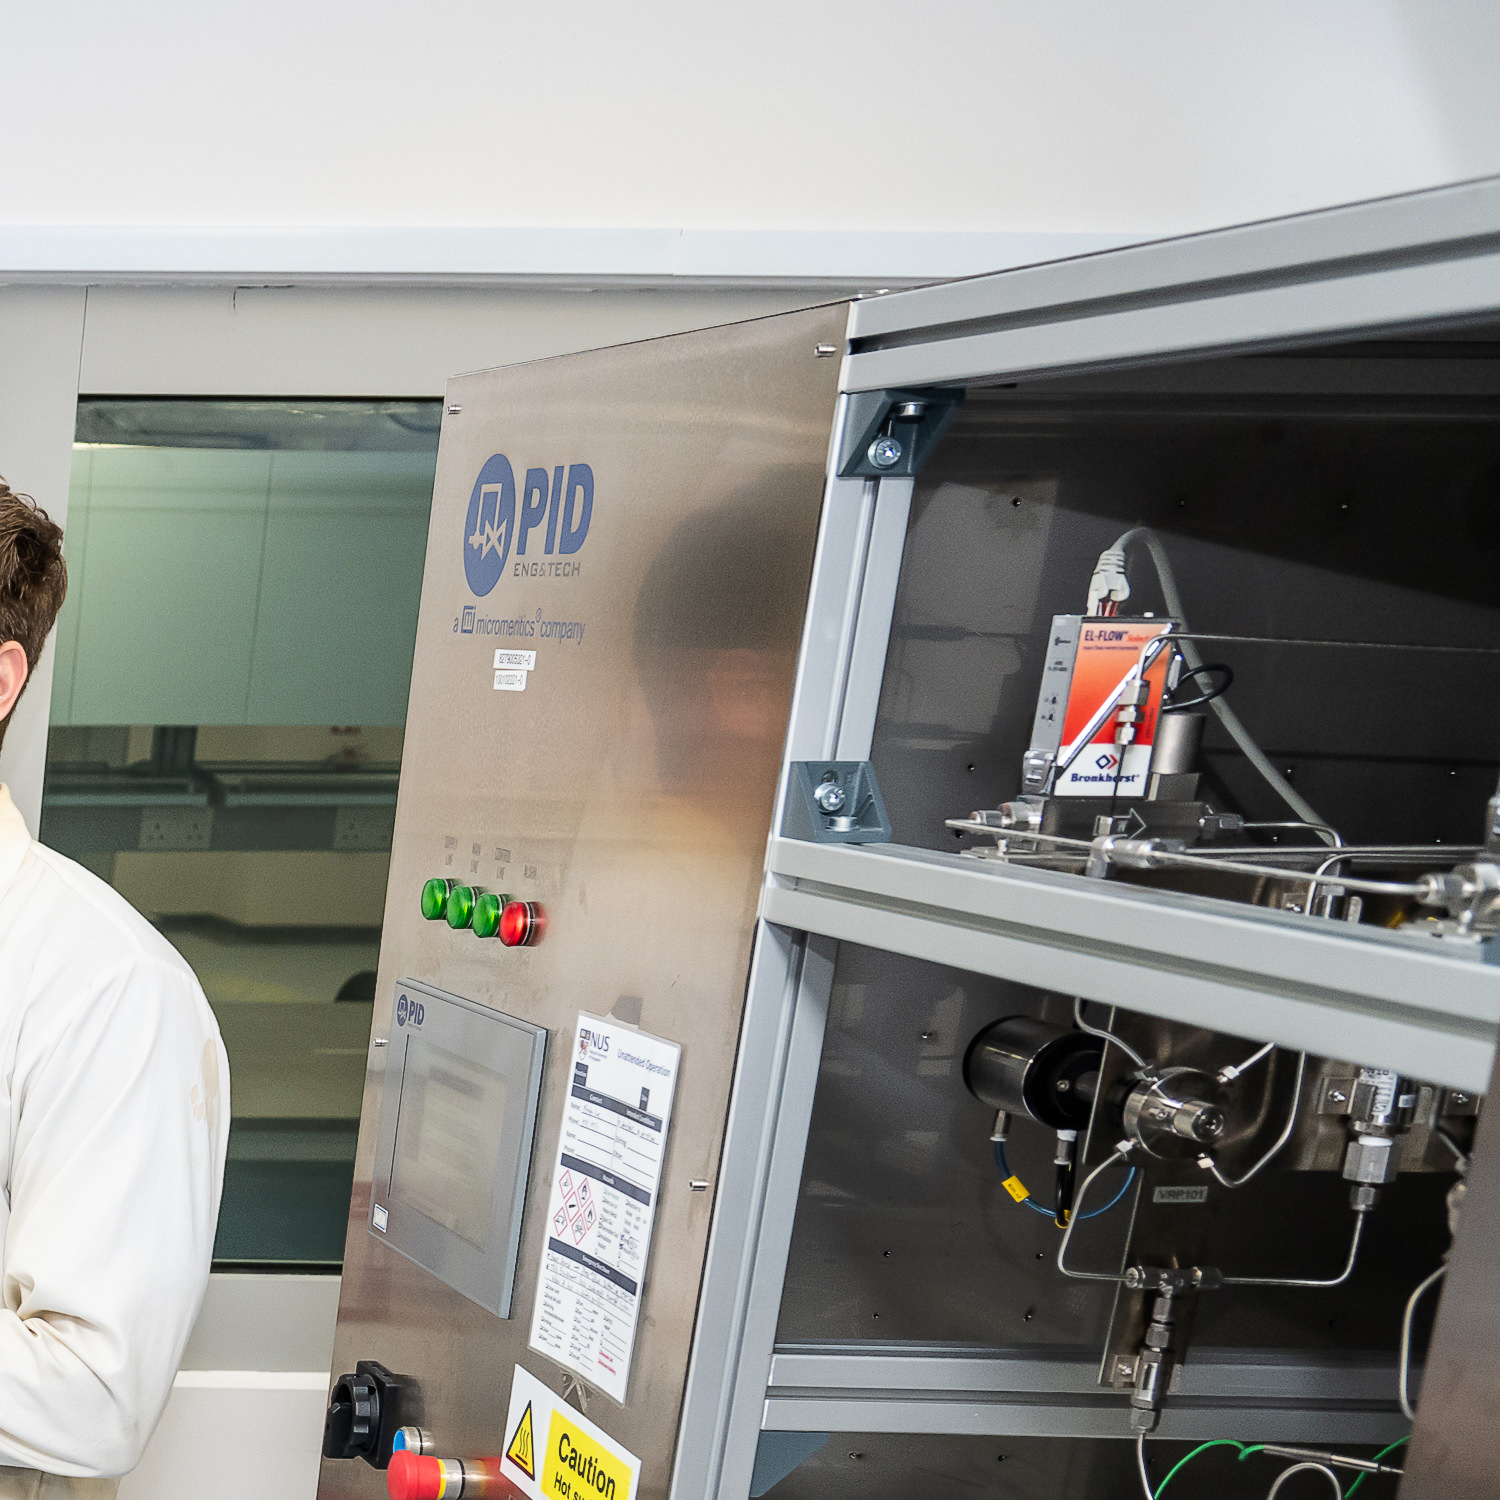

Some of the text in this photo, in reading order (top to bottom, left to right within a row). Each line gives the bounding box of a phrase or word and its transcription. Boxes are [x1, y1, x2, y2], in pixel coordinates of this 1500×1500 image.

[516, 463, 594, 556] PID
[512, 562, 581, 577] ENG&TECH
[540, 621, 585, 645] company
[408, 1000, 425, 1026] PID
[590, 1032, 610, 1053] NUS
[554, 1471, 571, 1500] Hot
